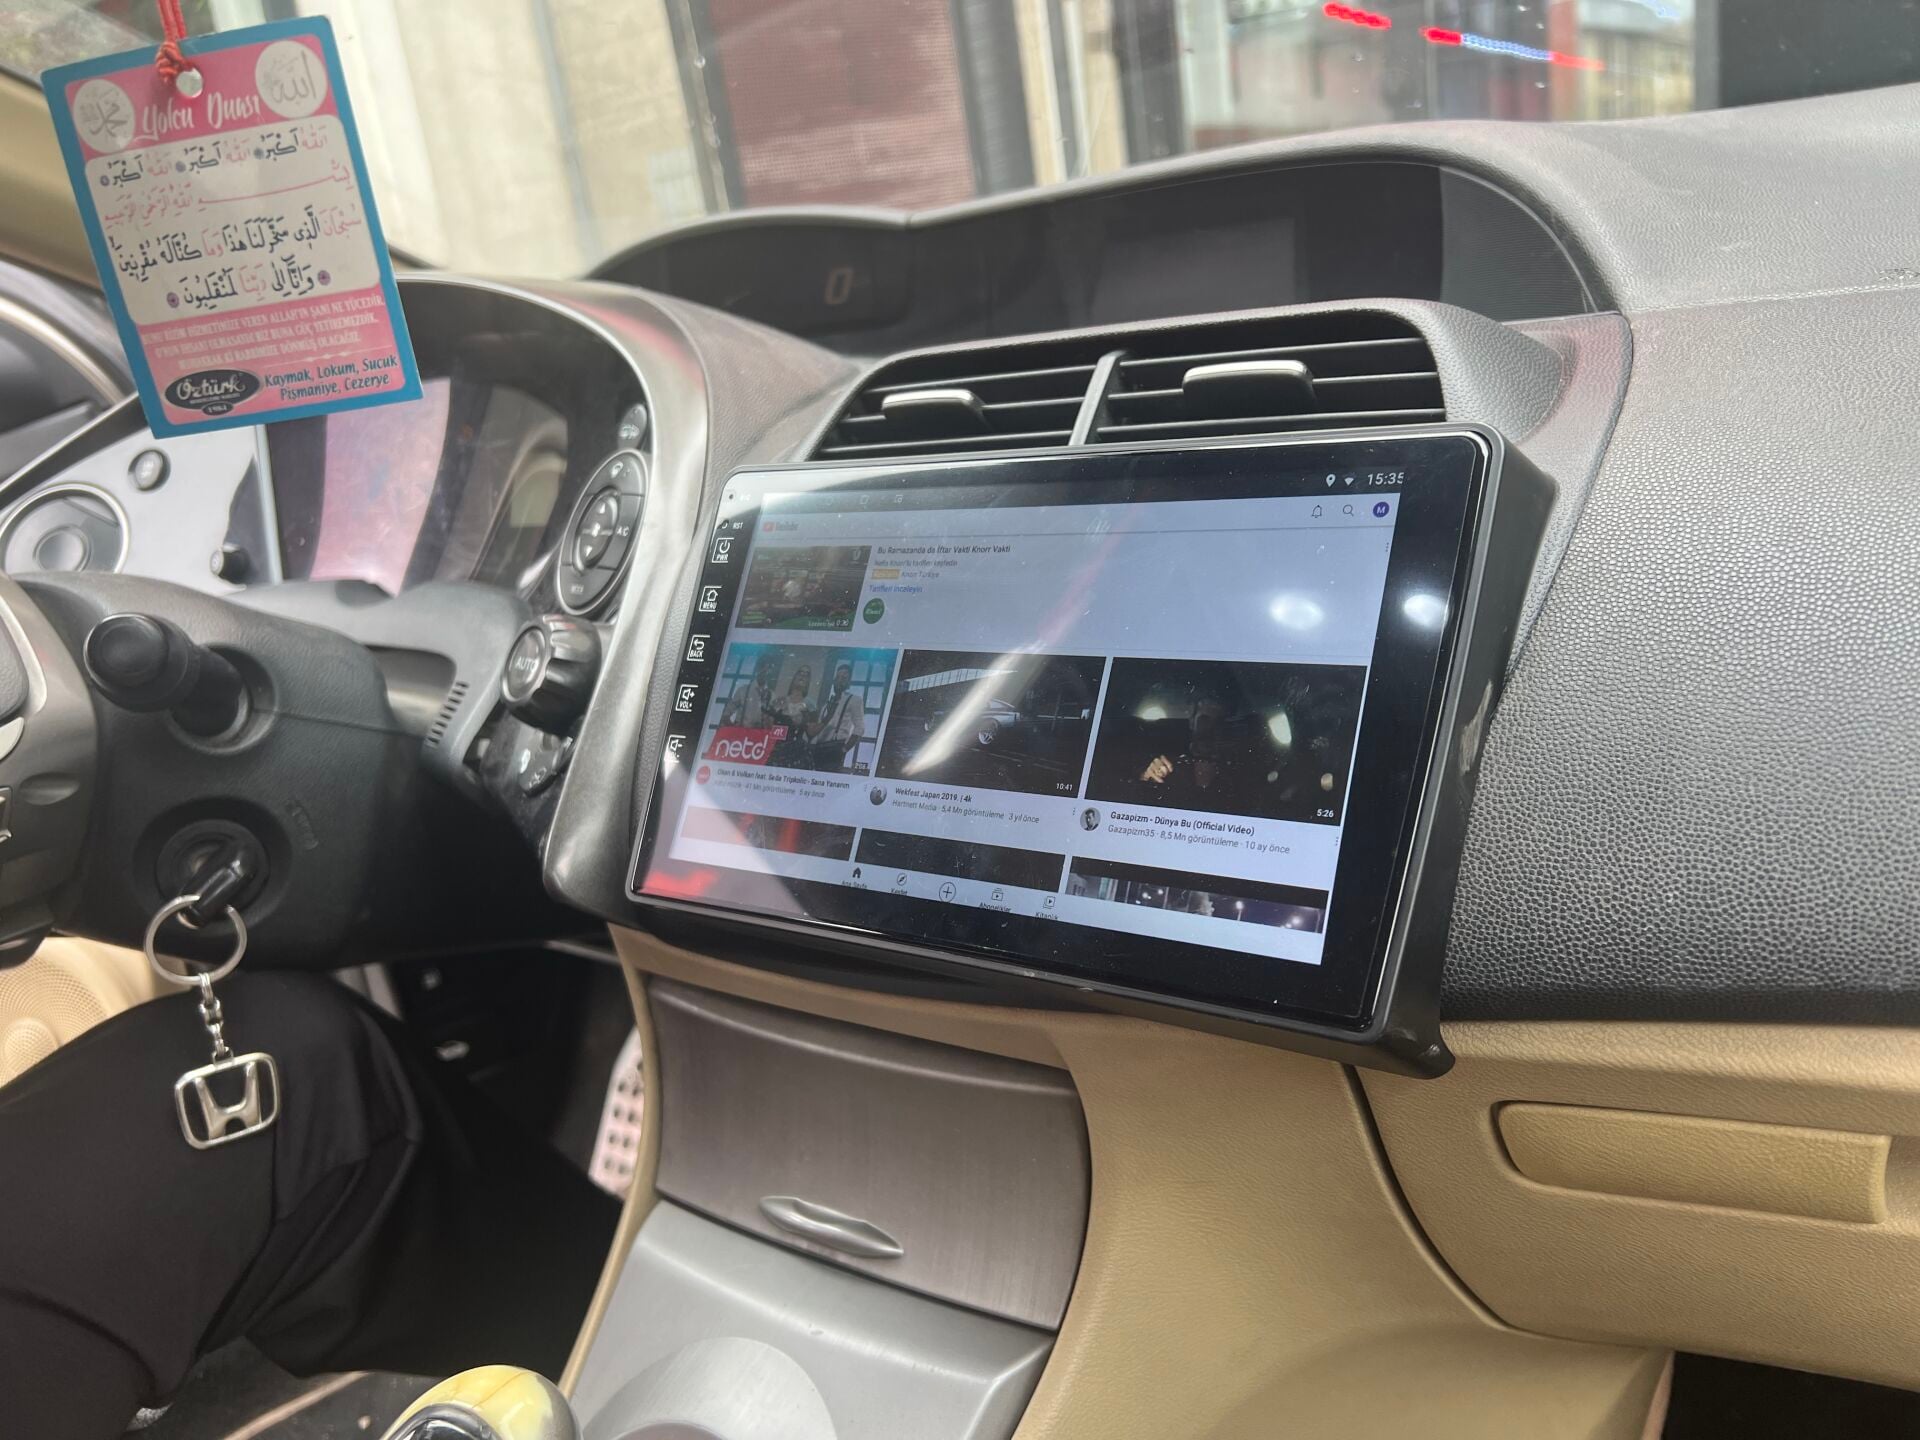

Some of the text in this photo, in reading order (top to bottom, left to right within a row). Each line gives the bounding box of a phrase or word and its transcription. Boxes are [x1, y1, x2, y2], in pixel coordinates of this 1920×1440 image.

[133, 98, 194, 141] Yolcu
[264, 354, 398, 388] Kaymak, Lokum, Sucuk
[176, 374, 245, 400] Öztürk
[344, 373, 390, 392] Cezerye
[1367, 472, 1405, 486] 15:35
[972, 544, 991, 554] Knorr
[992, 544, 1011, 553] Vakti
[716, 553, 729, 561] PWR
[702, 602, 718, 610] MENU
[689, 649, 704, 659] BACK
[715, 734, 768, 760] netd
[895, 787, 920, 797] Wekfest
[920, 790, 940, 800] Japan
[1056, 782, 1073, 792] 10:41
[1023, 813, 1040, 824] önce
[1316, 808, 1334, 818] 5:26
[1110, 811, 1256, 837] Gazapizm Dünya Bu (Official Video)
[1108, 824, 1291, 854] Gazapizm35 8,5 Mn görüntüleme 10 ay önce
